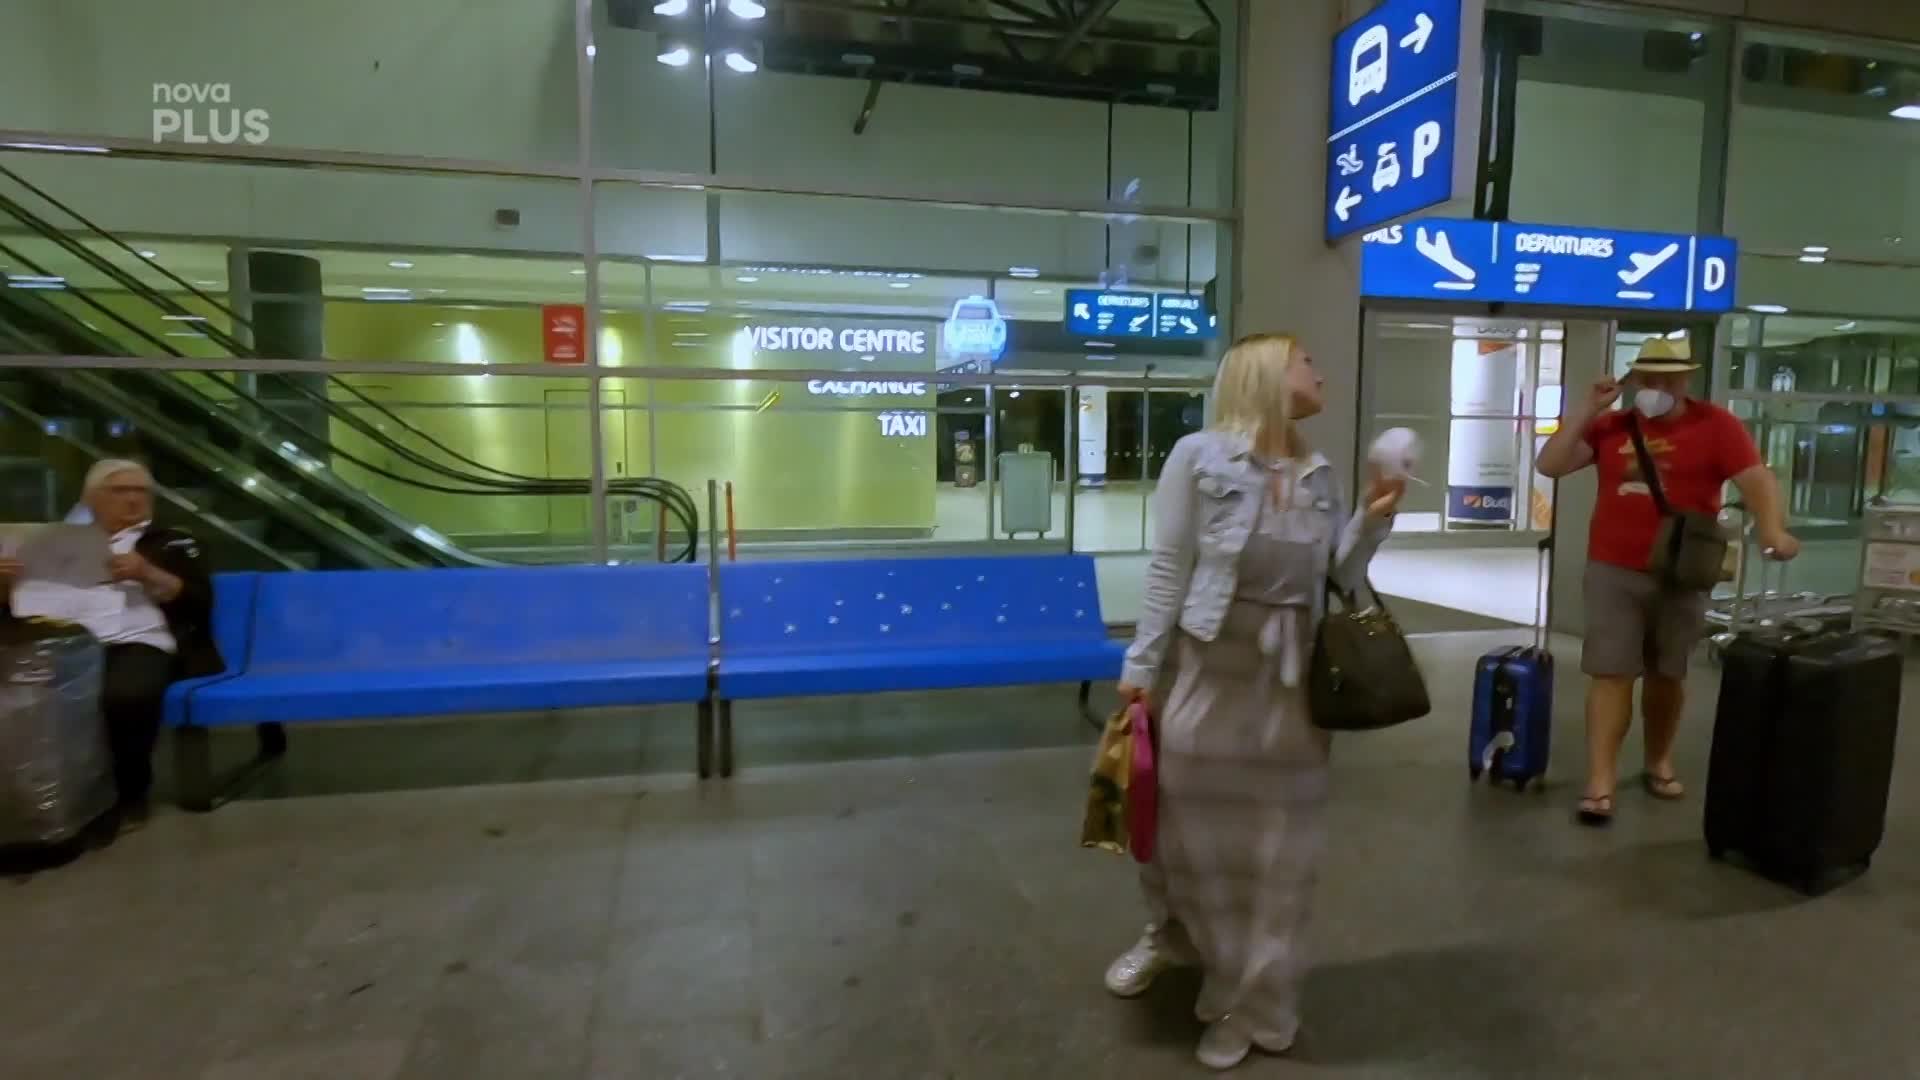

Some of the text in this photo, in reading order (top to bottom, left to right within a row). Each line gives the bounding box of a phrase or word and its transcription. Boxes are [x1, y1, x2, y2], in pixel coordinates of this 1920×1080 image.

[1411, 120, 1441, 179] P
[1515, 232, 1614, 258] DEPARTURES
[1703, 256, 1726, 292] D
[743, 325, 925, 354] VISITOR CENTRE
[877, 412, 926, 437] TAXI
